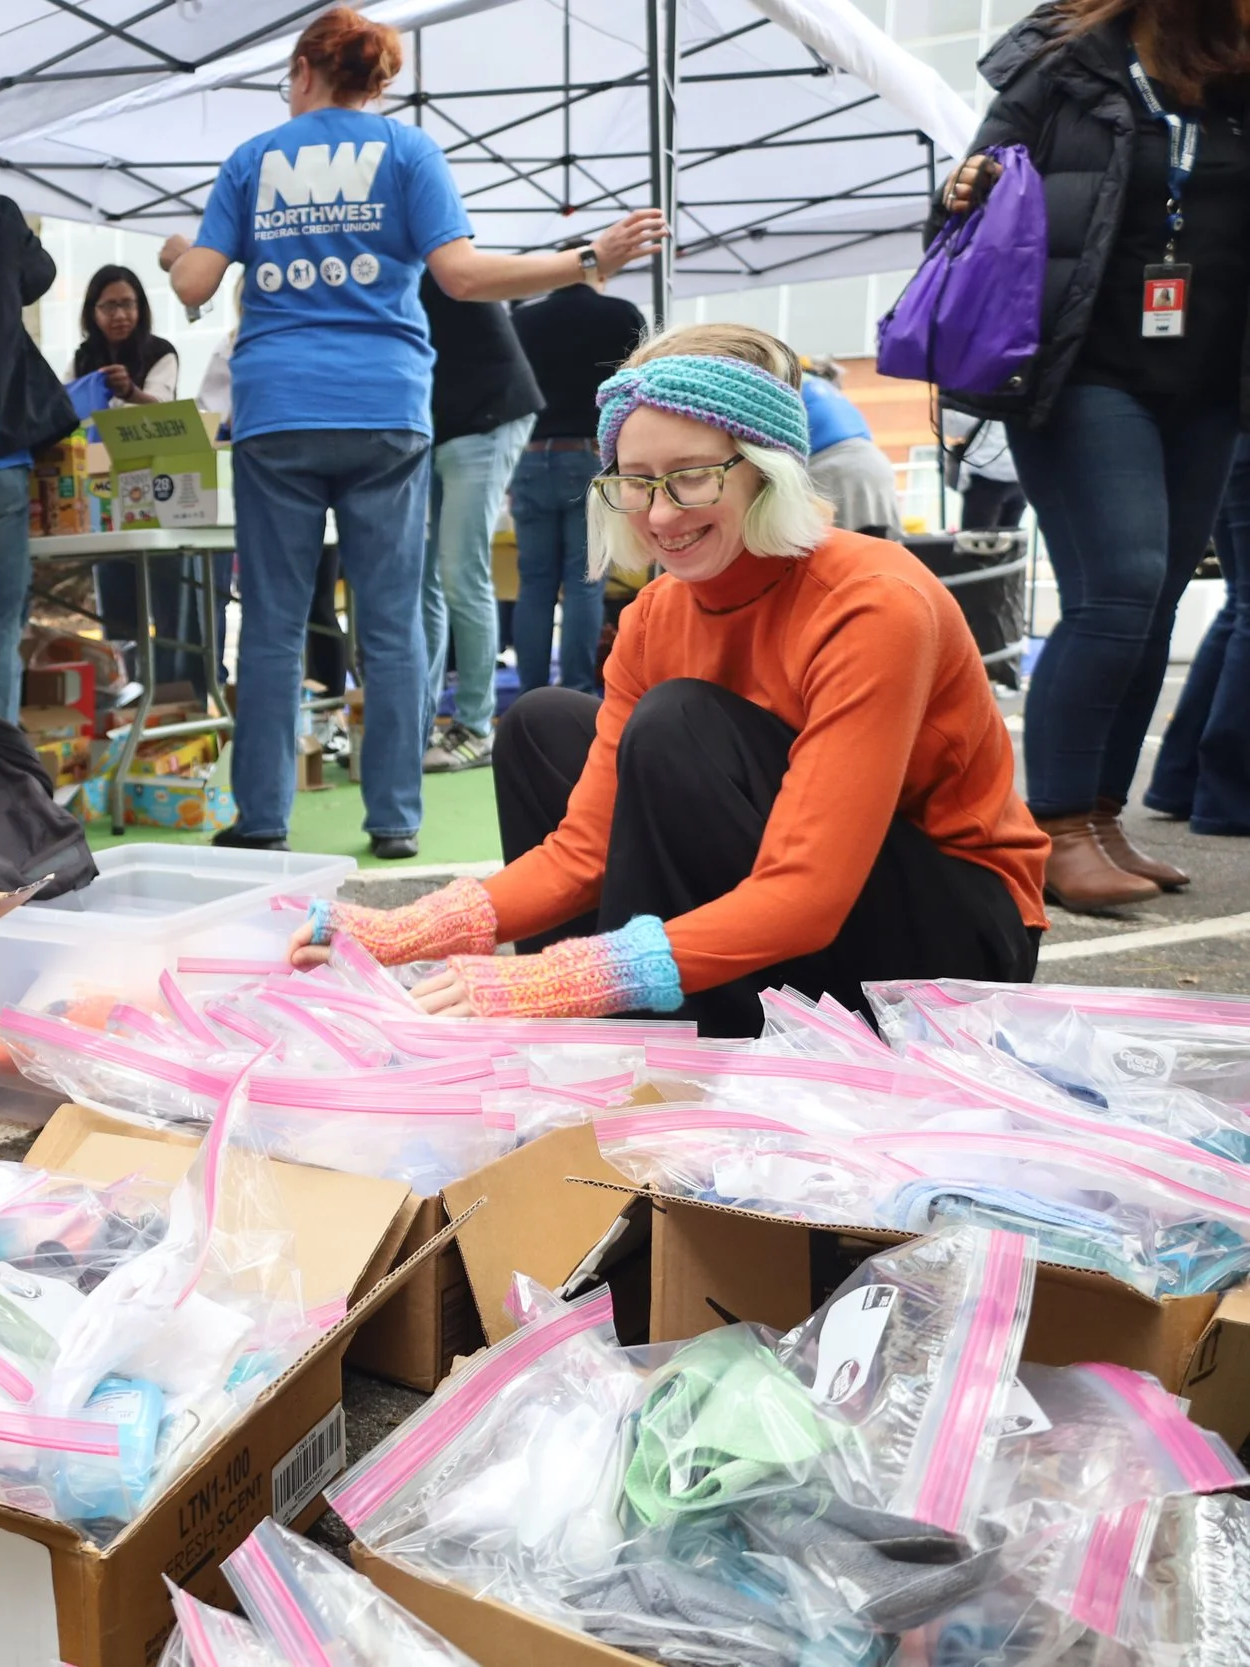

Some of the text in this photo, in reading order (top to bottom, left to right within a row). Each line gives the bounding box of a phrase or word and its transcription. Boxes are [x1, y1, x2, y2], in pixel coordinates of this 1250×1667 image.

[255, 142, 387, 213] NW
[254, 203, 385, 230] NORTHWEST
[254, 221, 381, 241] FEDERAL CREDIT UNION
[114, 419, 188, 443] HERE'S THE
[154, 478, 170, 491] 28
[1119, 1049, 1158, 1069] Great
[1127, 1060, 1156, 1075] Value
[179, 1446, 250, 1539] LTN1-100
[164, 1518, 217, 1578] FRESH
[217, 1472, 264, 1536] SCENT
